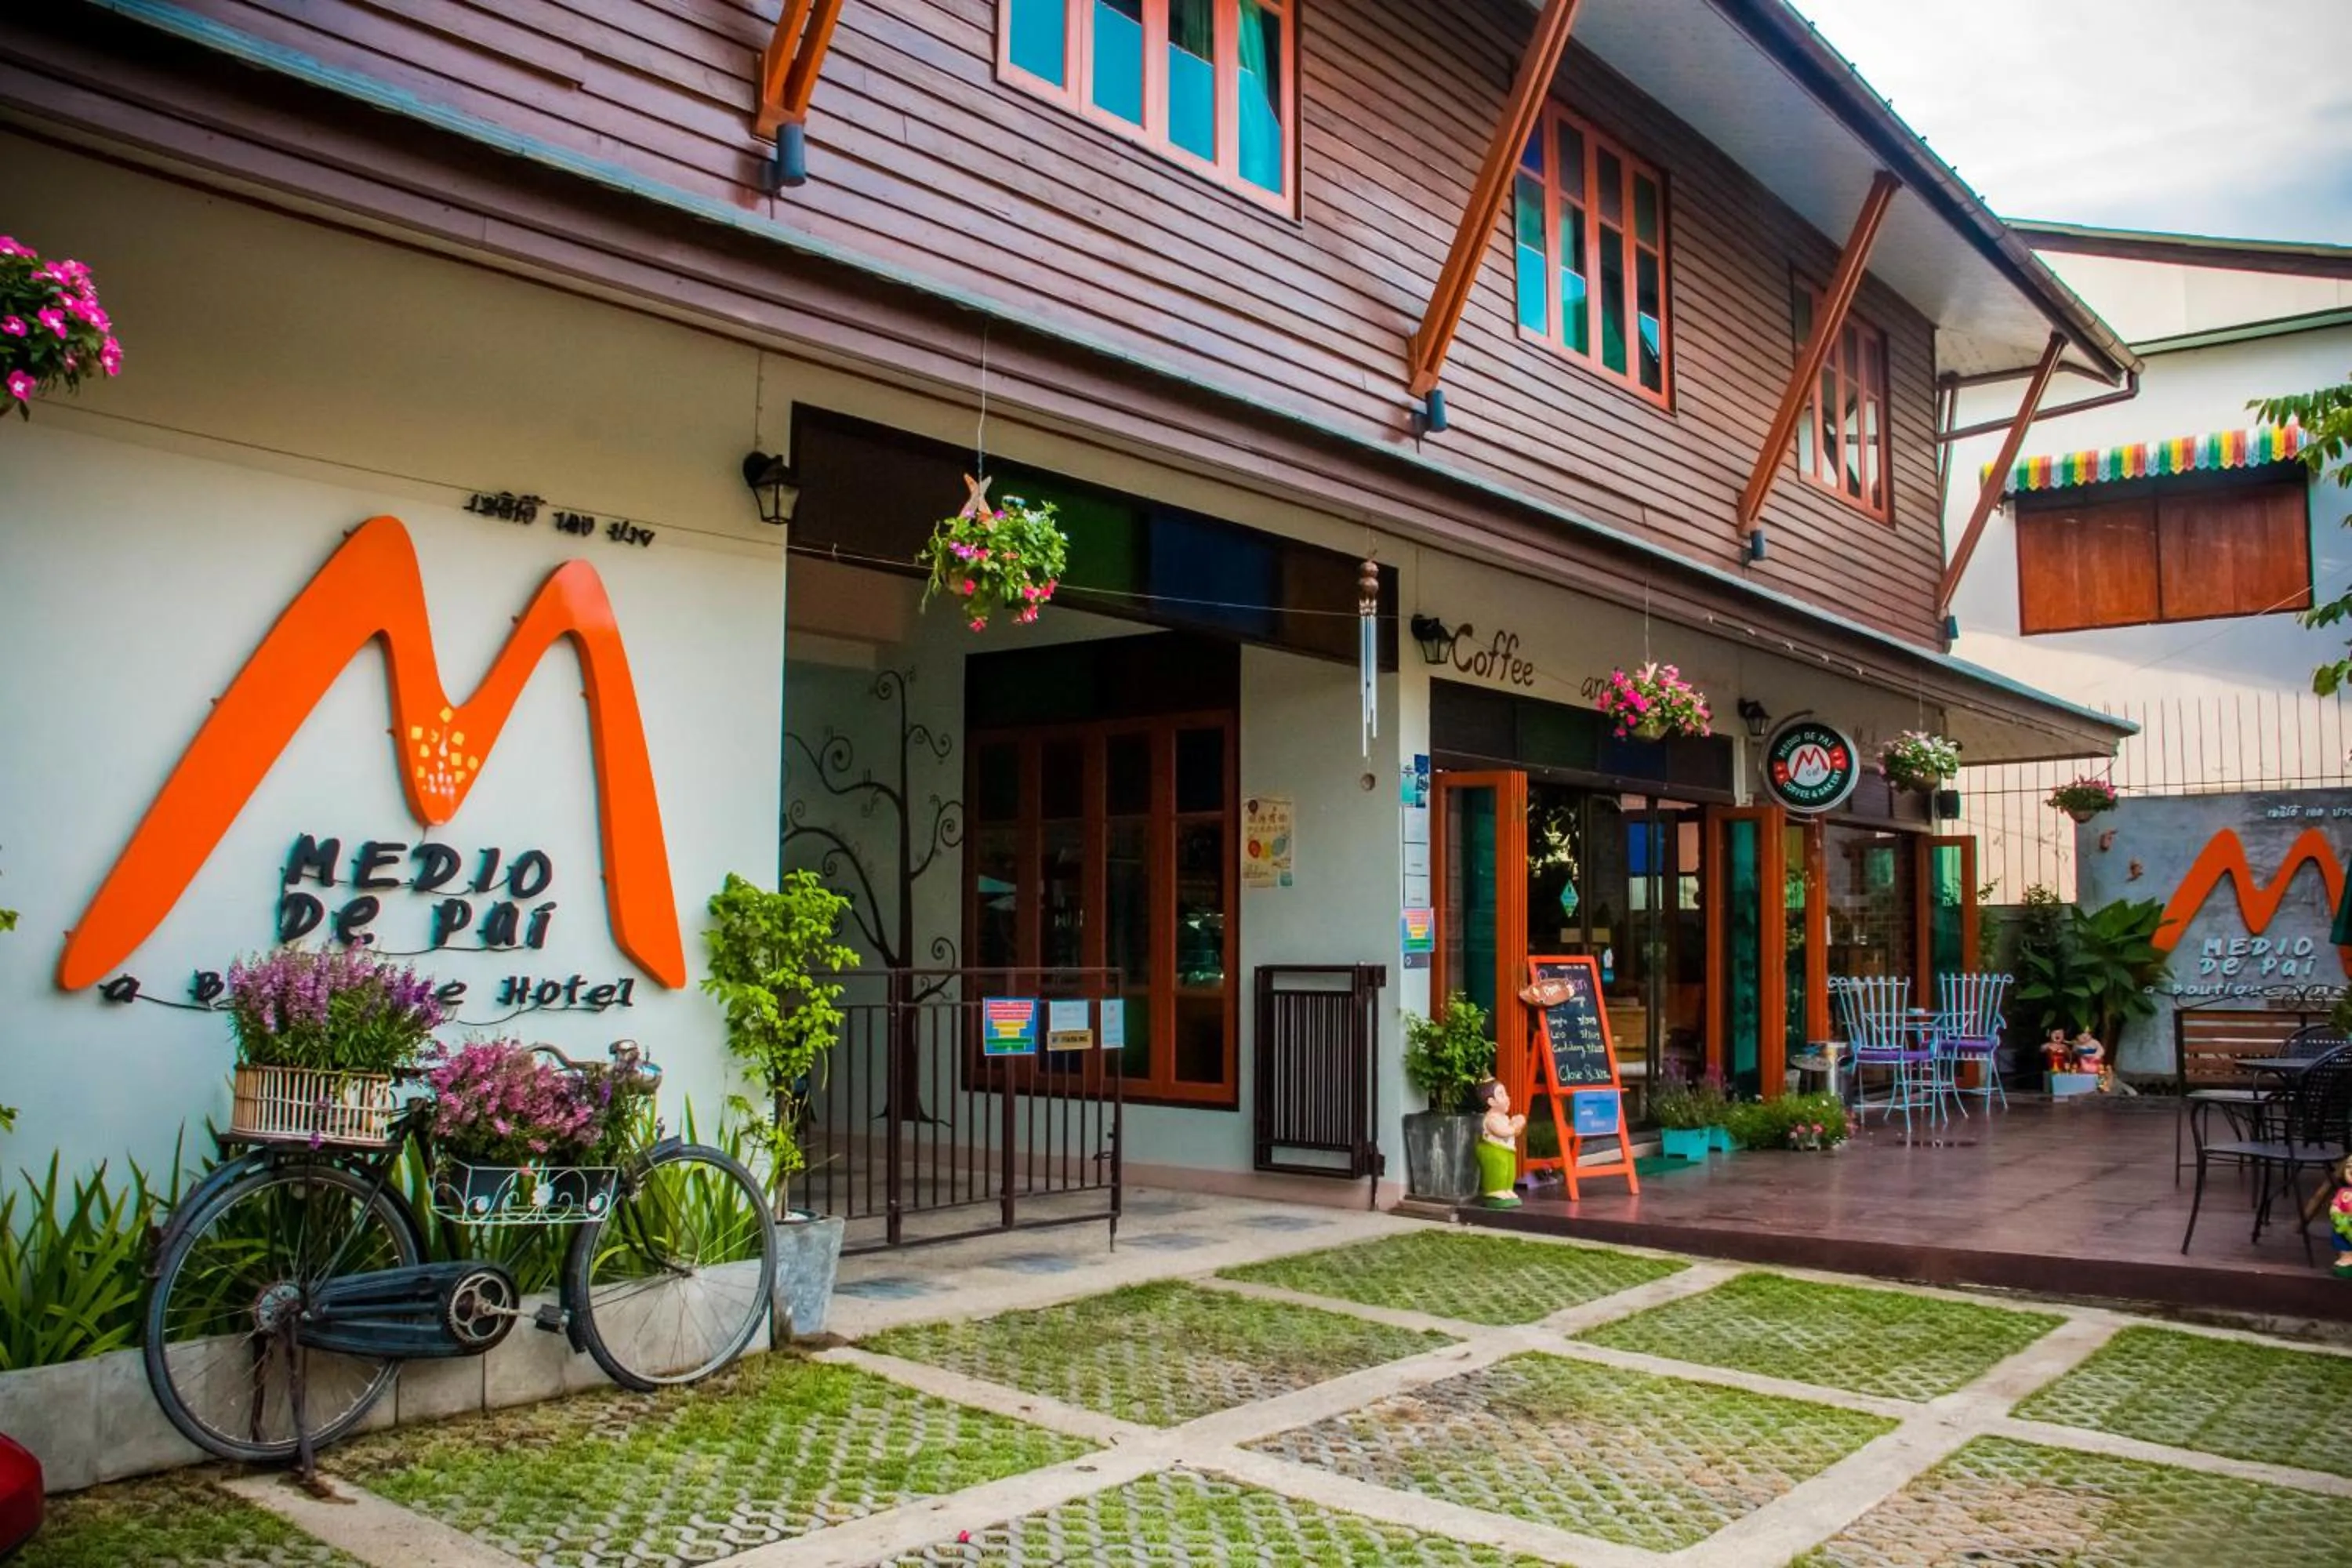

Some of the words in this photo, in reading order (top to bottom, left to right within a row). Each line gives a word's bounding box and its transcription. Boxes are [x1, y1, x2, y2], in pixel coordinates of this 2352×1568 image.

[1451, 622, 1534, 687] Coffee
[1779, 735, 1801, 757] MEDIO
[1803, 731, 1817, 741] DE
[282, 833, 553, 900] MEDIO
[2201, 936, 2314, 957] MEDIO
[497, 974, 635, 1011] Hotel
[1558, 1063, 1583, 1082] Close
